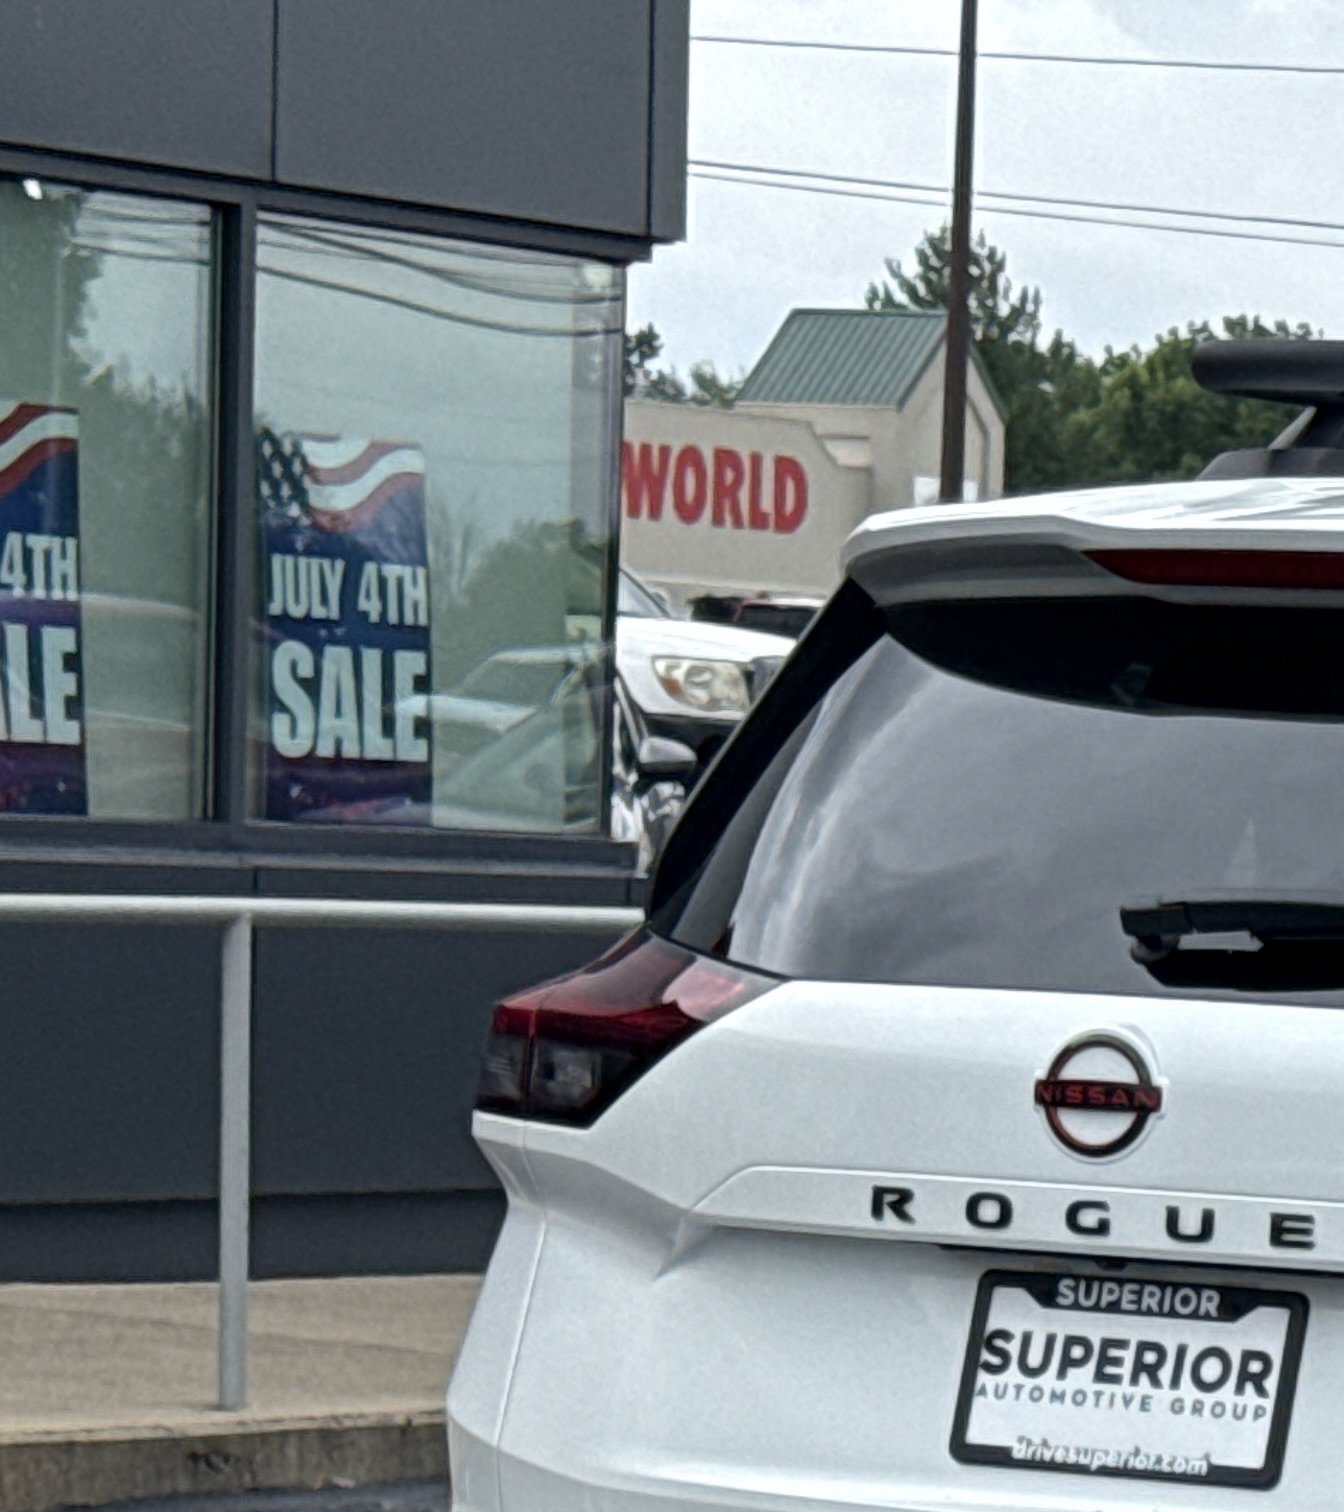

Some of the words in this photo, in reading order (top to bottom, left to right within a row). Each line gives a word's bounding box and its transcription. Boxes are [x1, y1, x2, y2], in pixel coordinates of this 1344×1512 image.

[623, 441, 809, 535] WORLD
[0, 531, 79, 602] 4TH
[268, 552, 346, 621] JULY
[357, 560, 429, 628] 4TH
[0, 622, 82, 746] LE
[271, 639, 429, 763] SALE
[1038, 1082, 1160, 1110] NISSAN
[871, 1184, 1317, 1250] ROGUE
[1055, 1277, 1221, 1318] SUPERIOR
[979, 1328, 1274, 1400] SUPERIOR
[974, 1381, 1154, 1413] AUTOMOTIVE
[1169, 1396, 1268, 1423] GROUP
